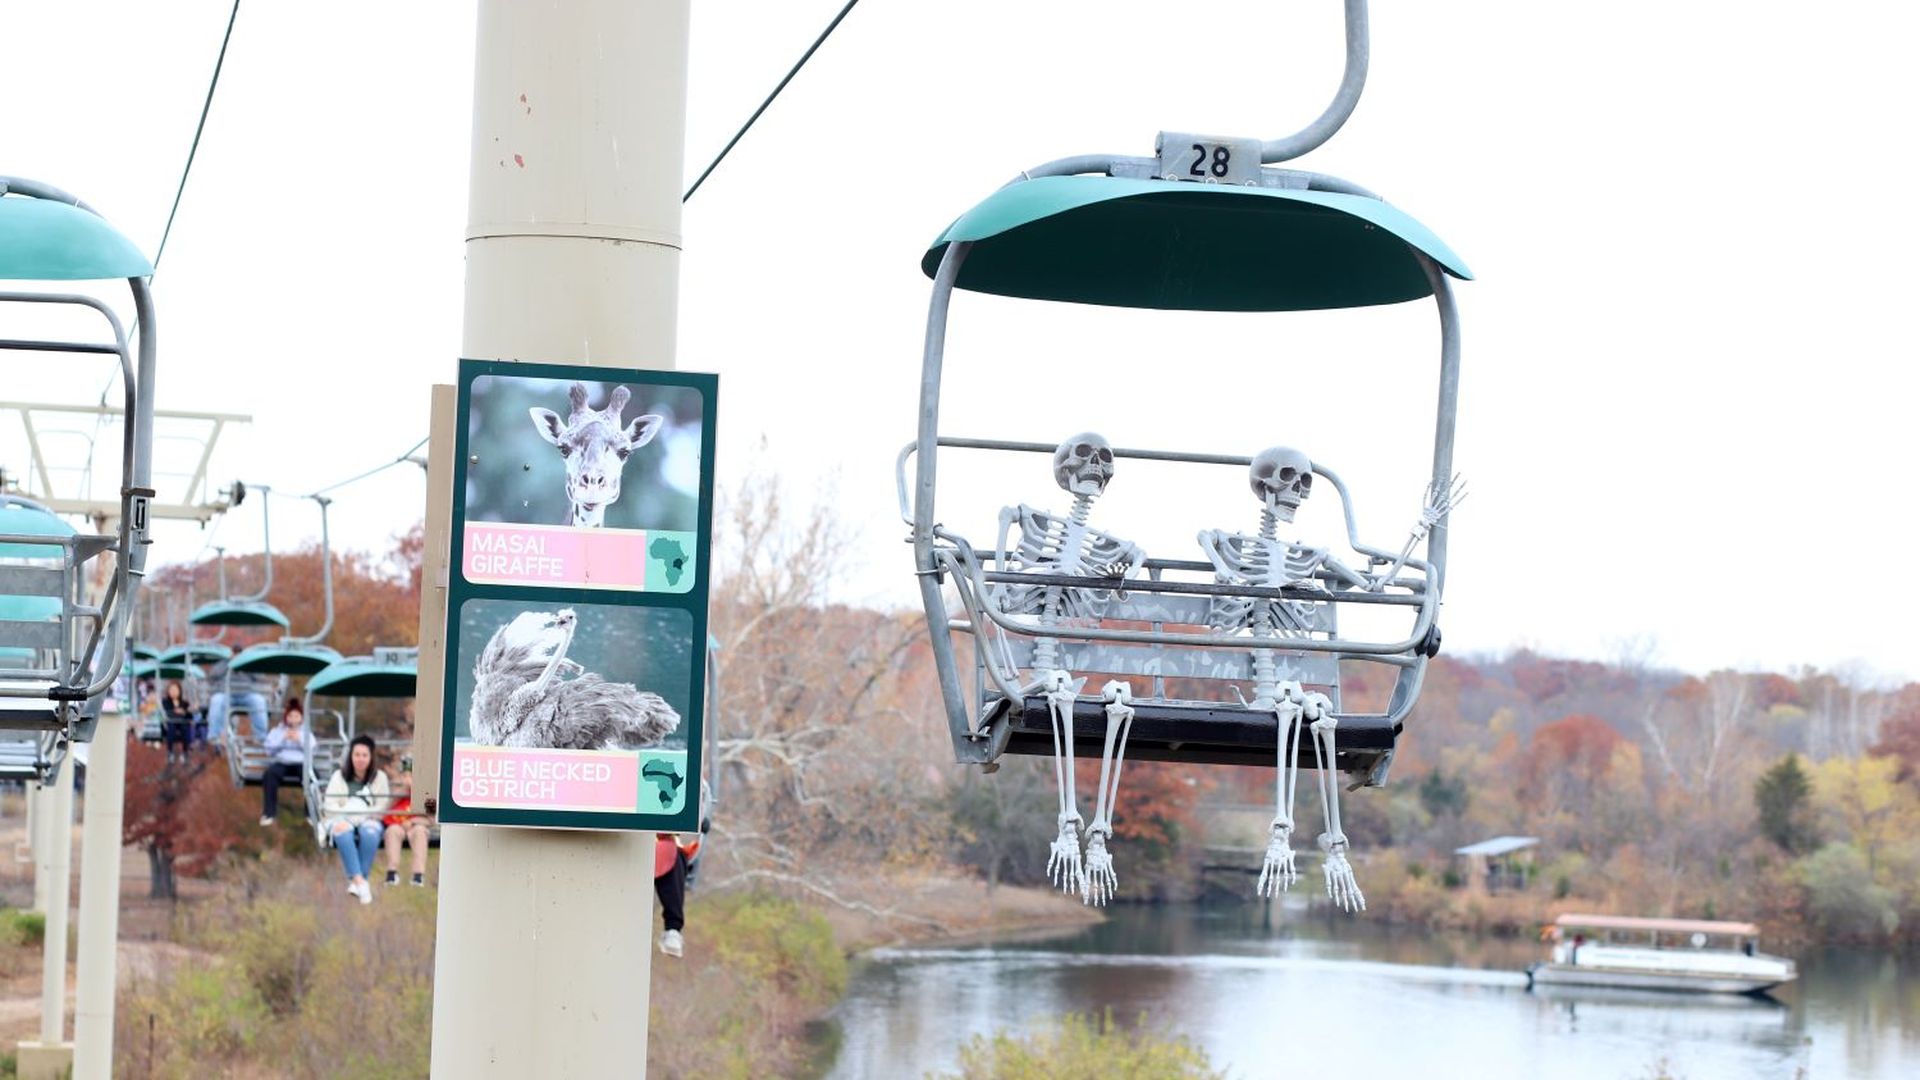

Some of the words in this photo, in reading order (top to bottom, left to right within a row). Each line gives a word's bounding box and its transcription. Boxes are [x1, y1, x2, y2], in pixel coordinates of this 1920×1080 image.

[1190, 144, 1231, 177] 28
[472, 532, 546, 555] MASAI
[470, 554, 564, 577] GIRAFFE
[460, 758, 516, 778] BLUE
[522, 761, 611, 782] NECKED
[459, 778, 556, 799] OSTRICH
